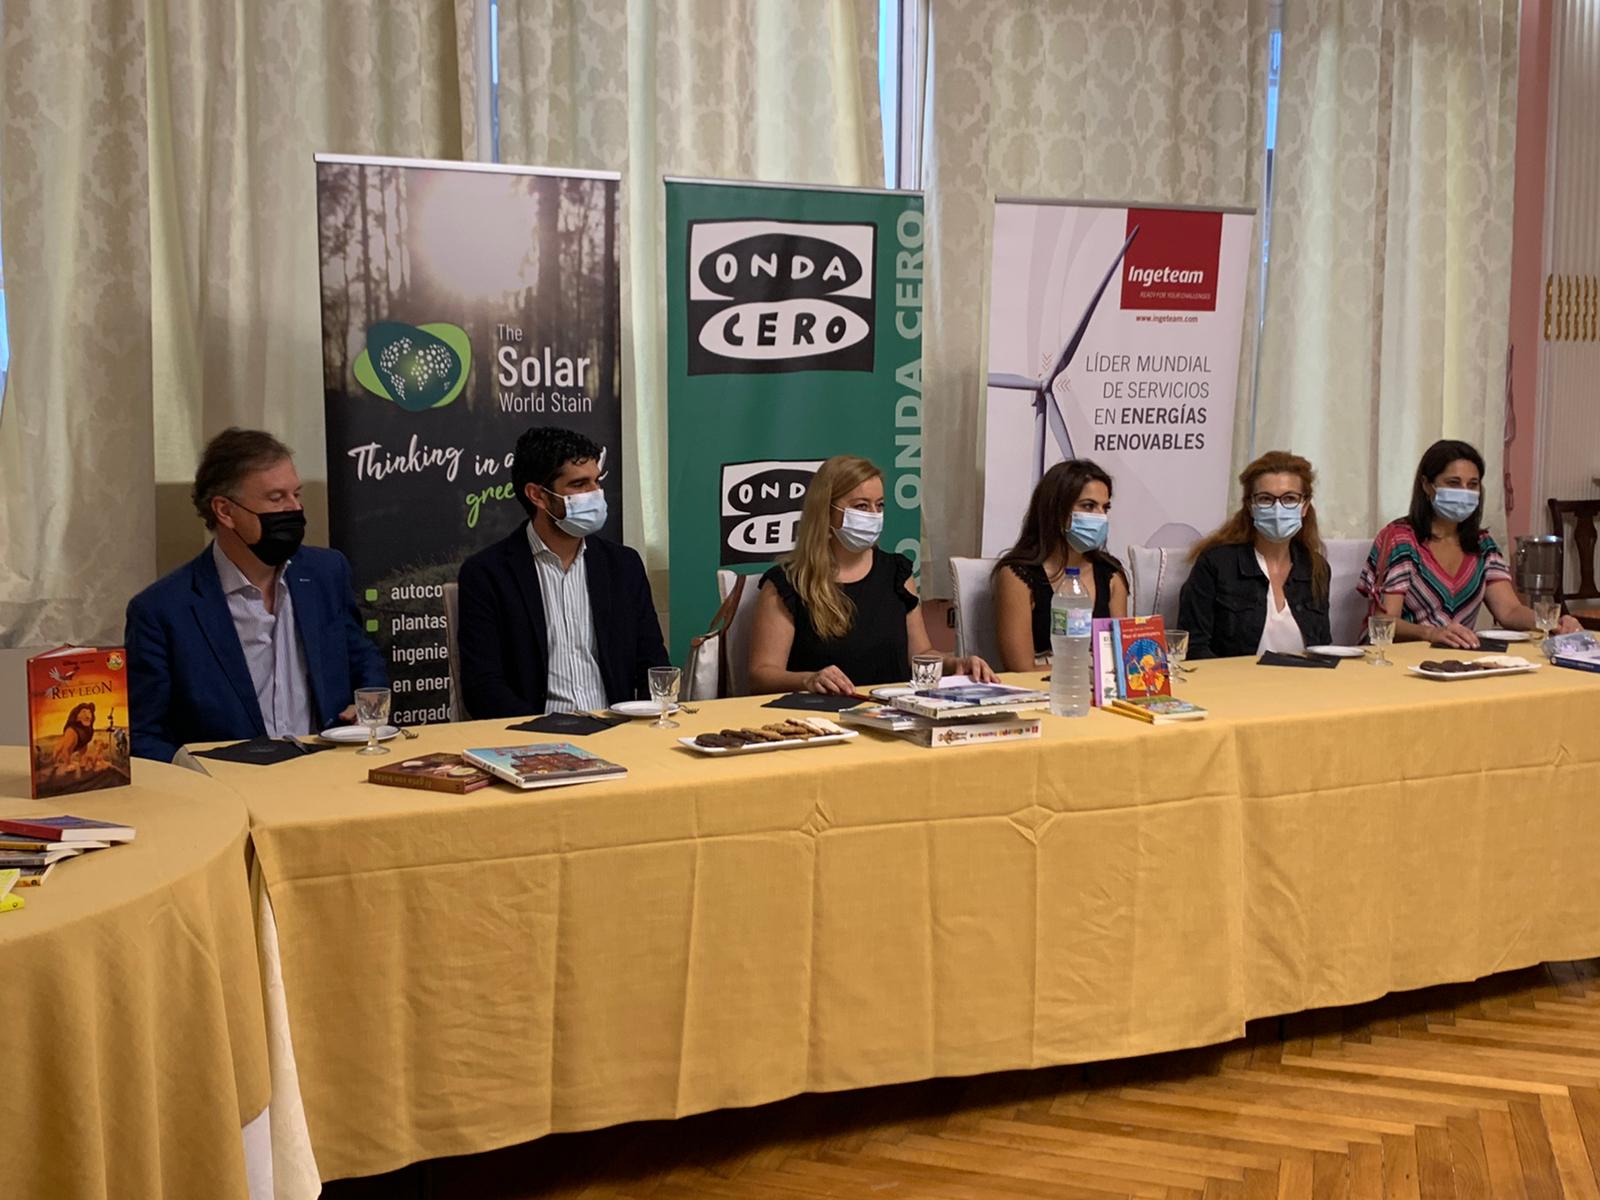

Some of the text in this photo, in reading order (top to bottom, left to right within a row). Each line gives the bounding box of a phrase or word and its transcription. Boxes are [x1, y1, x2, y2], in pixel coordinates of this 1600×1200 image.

[715, 253, 847, 283] ONDA
[896, 209, 924, 339] CERO
[1128, 265, 1204, 287] Ingeteam
[723, 312, 847, 346] CERO
[1136, 314, 1198, 324] www.ingeteam.com
[498, 323, 523, 342] The
[498, 347, 590, 387] Solar
[1086, 352, 1211, 373] LÍDER MUNDIAL
[1103, 381, 1209, 399] DE SERVICIOS
[499, 391, 592, 413] World Stain
[1094, 404, 1207, 425] EN ENERGÍAS
[895, 358, 922, 509] ONDA
[1094, 433, 1204, 451] RENOVABLES
[348, 434, 464, 482] Thinking
[475, 455, 499, 476] in
[738, 482, 806, 504] OND
[466, 482, 516, 528] gree
[743, 520, 800, 545] CE
[391, 584, 443, 600] autoco
[392, 614, 448, 635] plantas
[392, 642, 448, 665] ingenie
[393, 676, 450, 693] en ener
